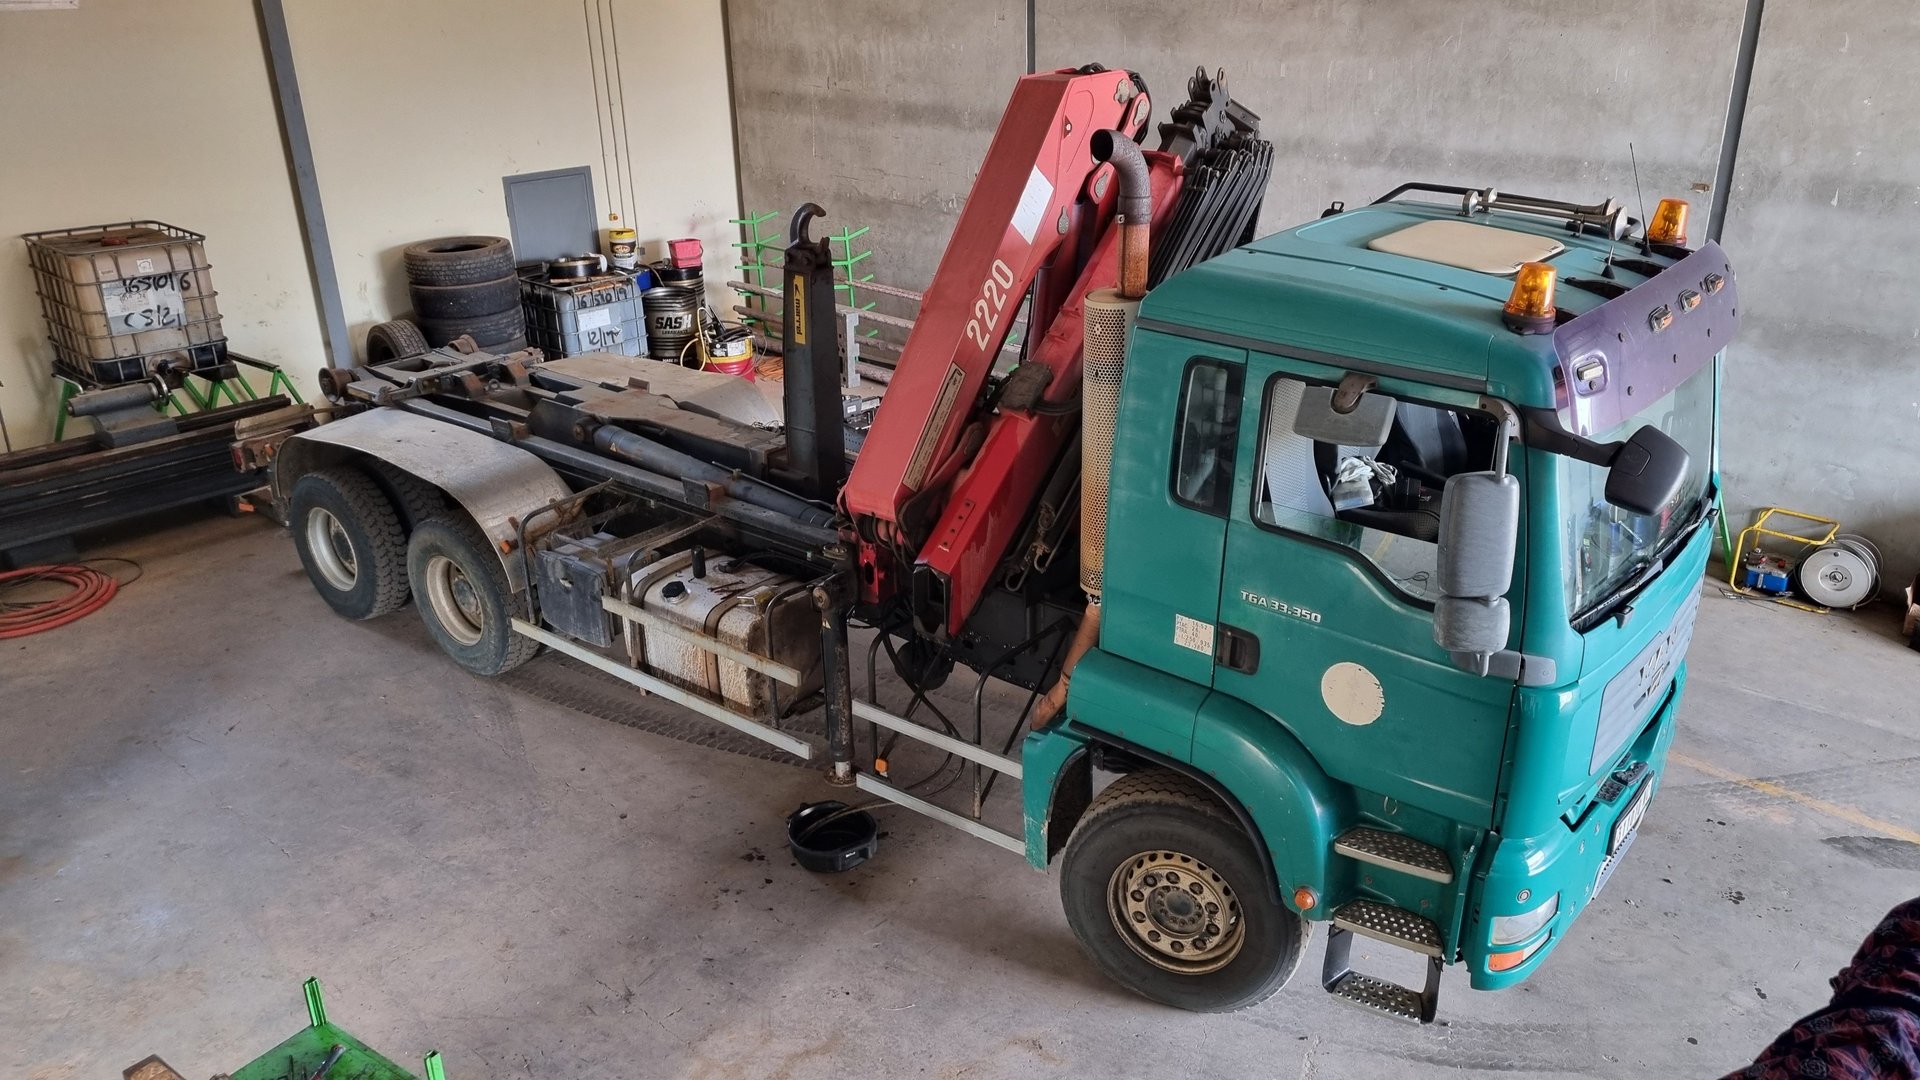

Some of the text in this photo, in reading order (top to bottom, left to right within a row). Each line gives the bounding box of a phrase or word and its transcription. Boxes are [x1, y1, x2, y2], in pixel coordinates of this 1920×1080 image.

[655, 313, 692, 330] SASH
[967, 259, 1014, 351] 2220
[1240, 590, 1321, 623] TGA 33.350
